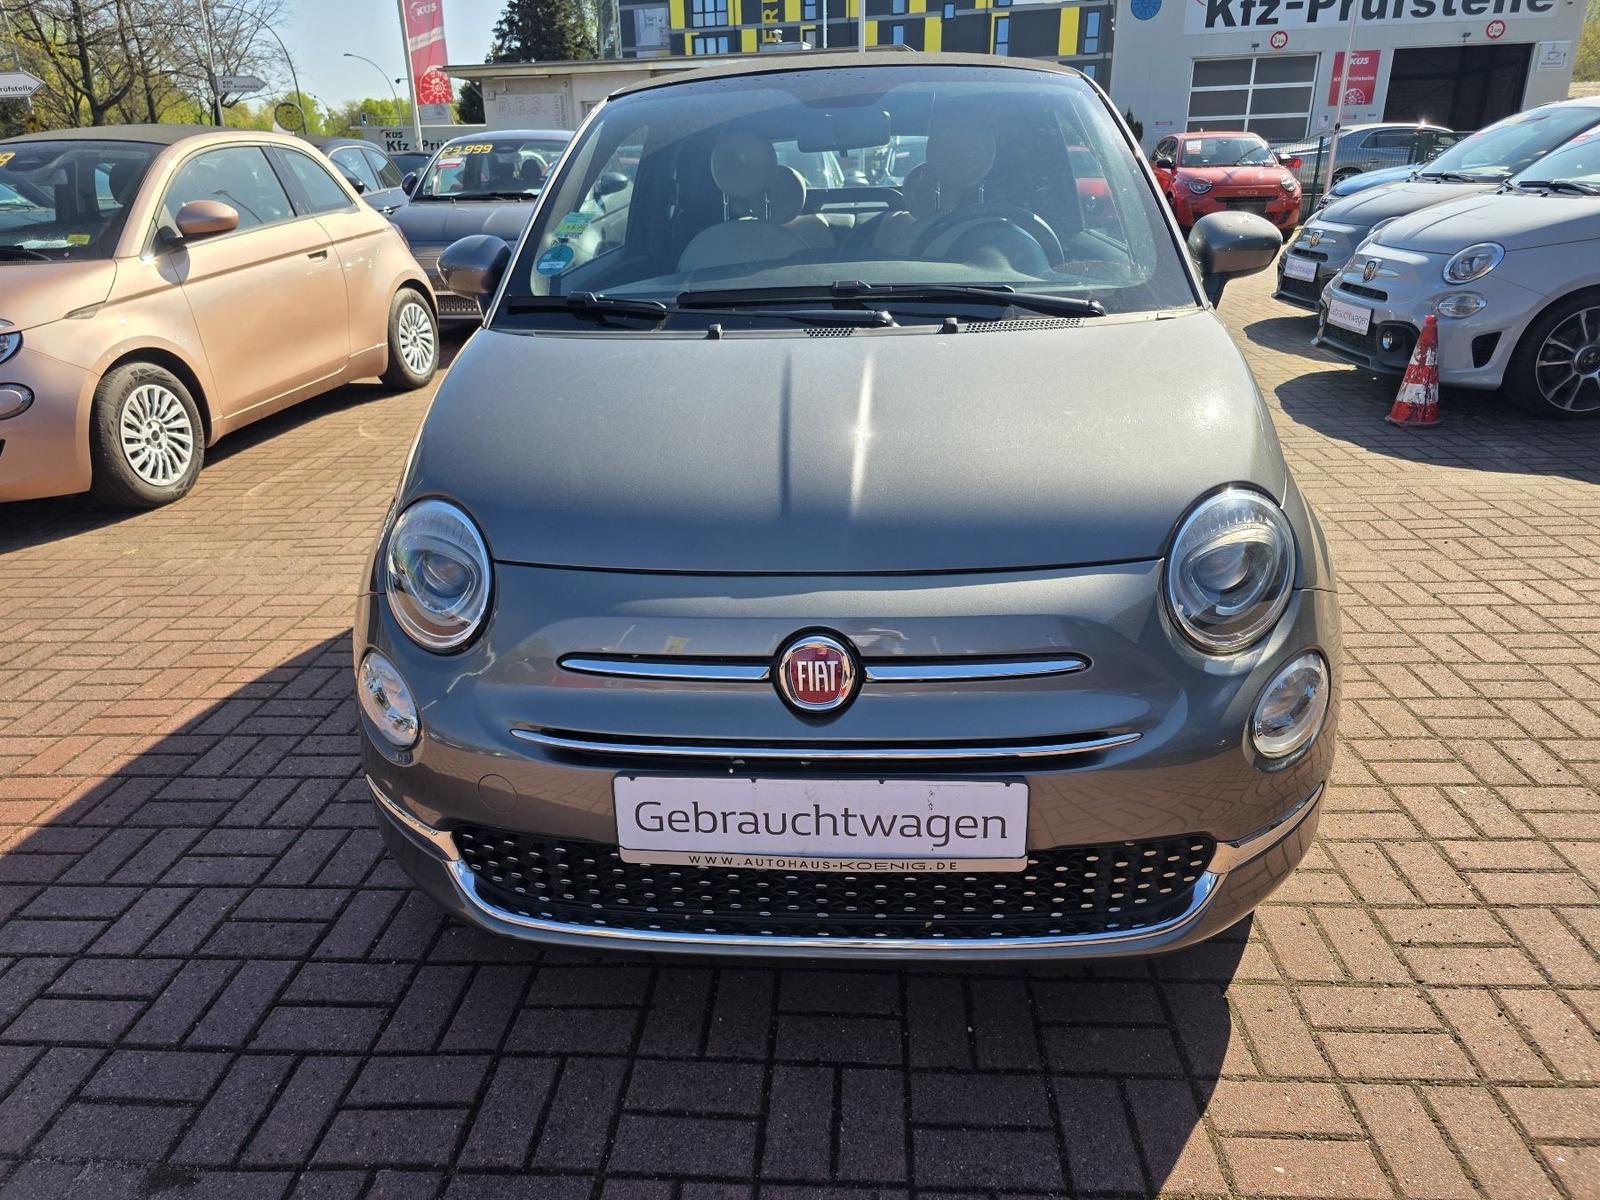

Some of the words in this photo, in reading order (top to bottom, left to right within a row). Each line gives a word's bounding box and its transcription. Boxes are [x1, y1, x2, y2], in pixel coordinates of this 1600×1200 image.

[797, 660, 839, 692] FIAT
[634, 801, 1008, 847] Gebrauchtwagen
[688, 854, 958, 871] WWW.AUTOHAUS-KOENIG.DE
